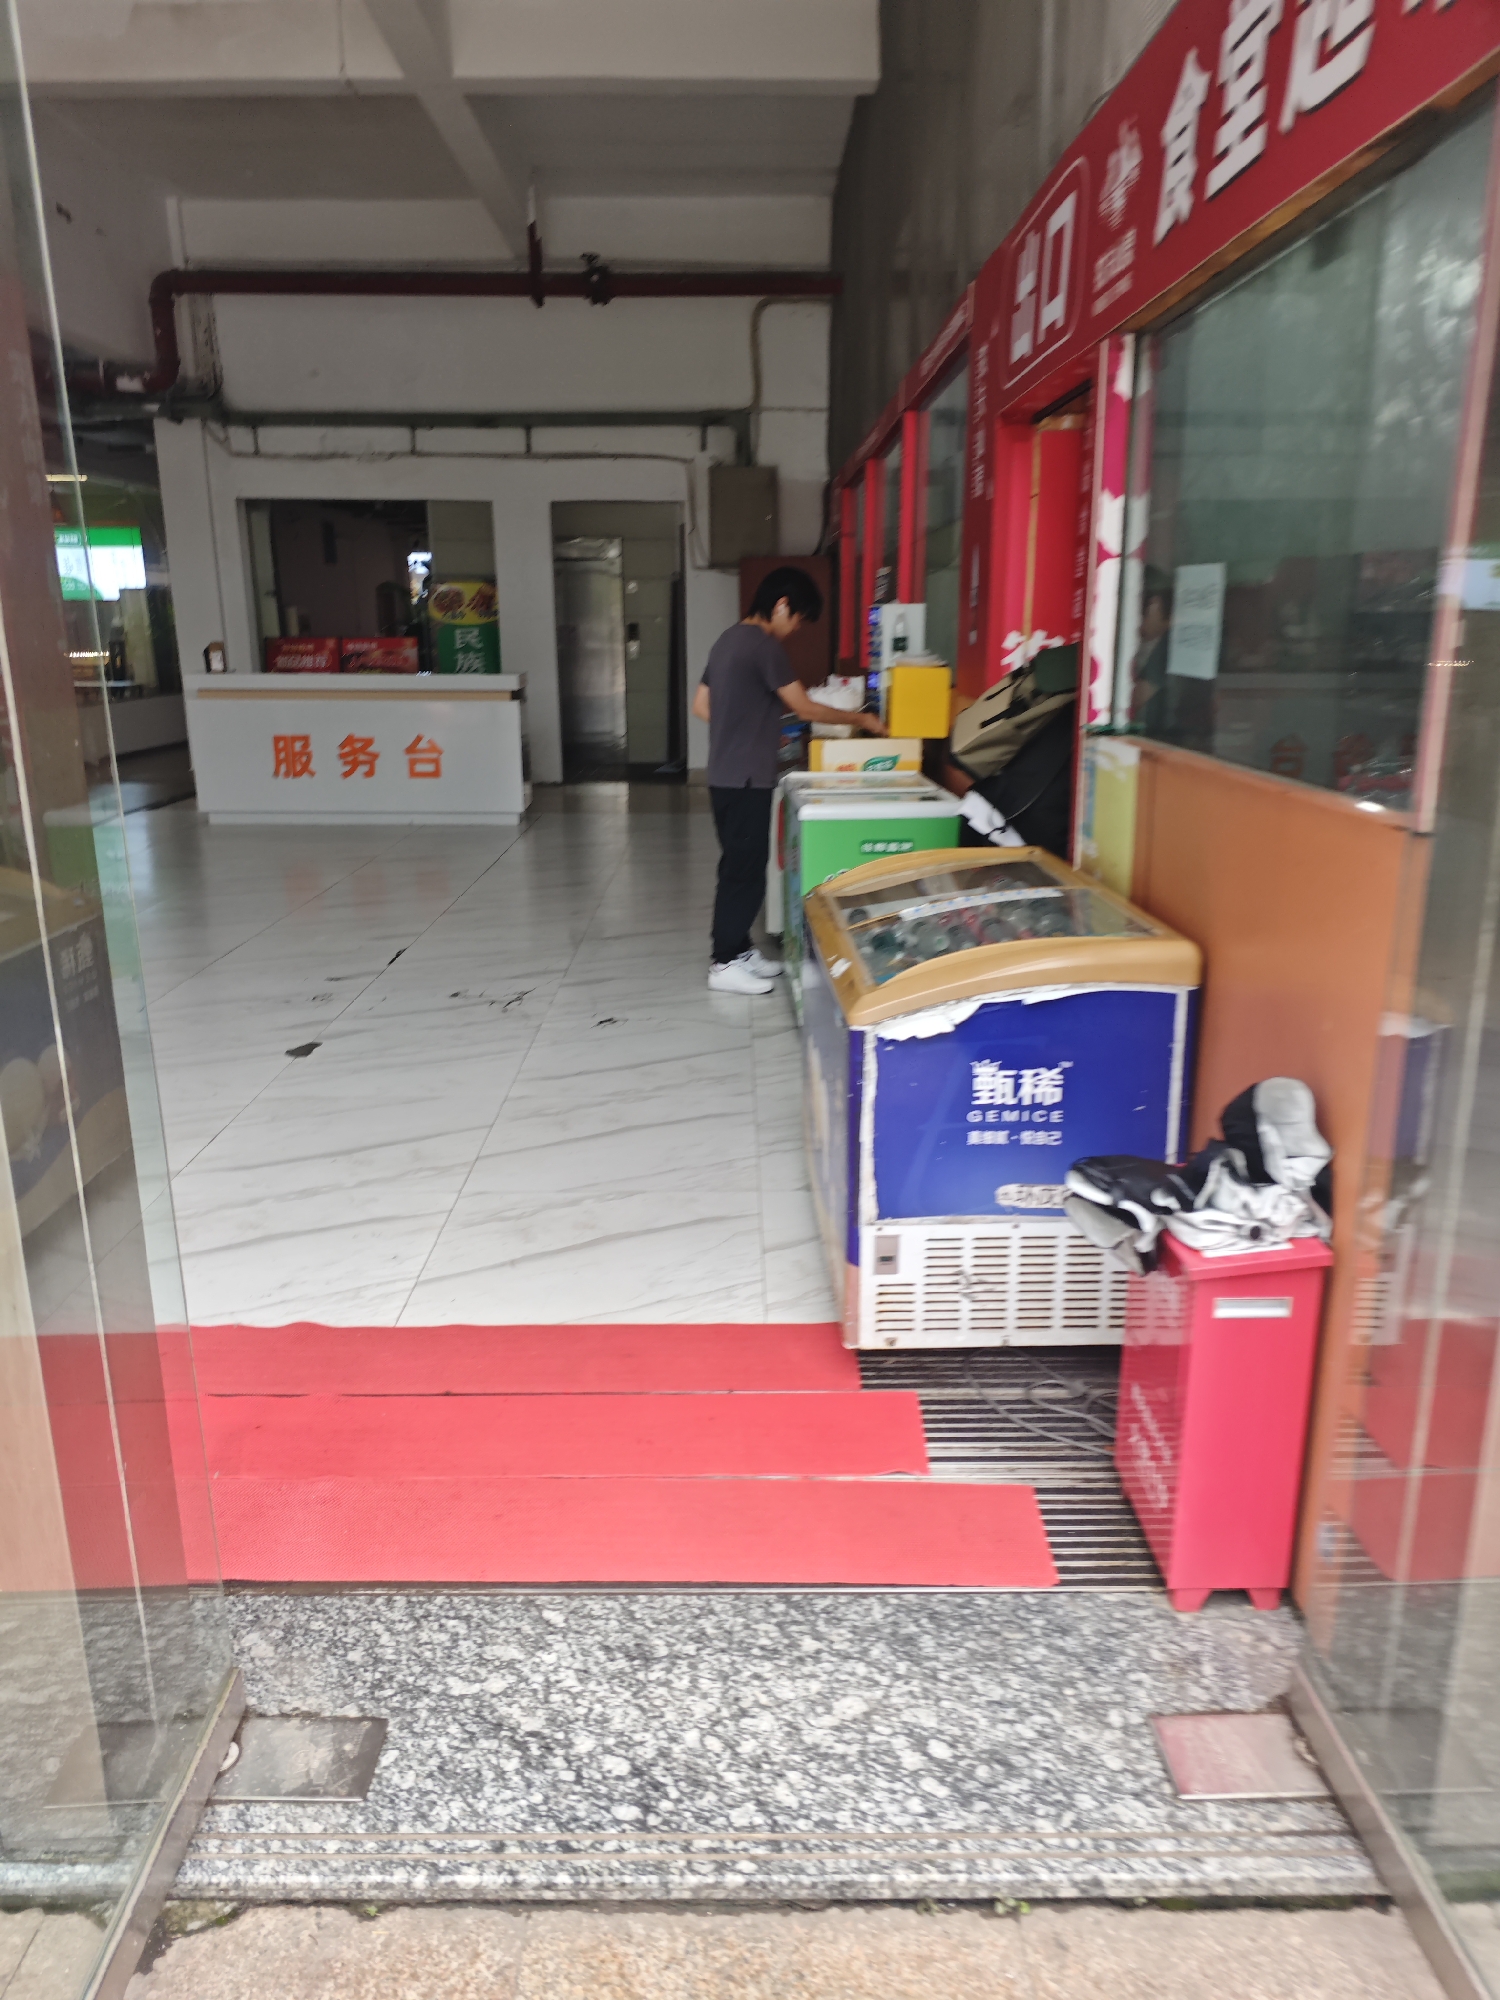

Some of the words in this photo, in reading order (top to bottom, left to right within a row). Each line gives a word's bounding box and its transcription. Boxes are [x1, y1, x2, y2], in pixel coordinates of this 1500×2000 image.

[272, 733, 444, 779] 服务台
[970, 1059, 1064, 1106] 甄稀
[966, 1110, 1064, 1123] GEMICE
